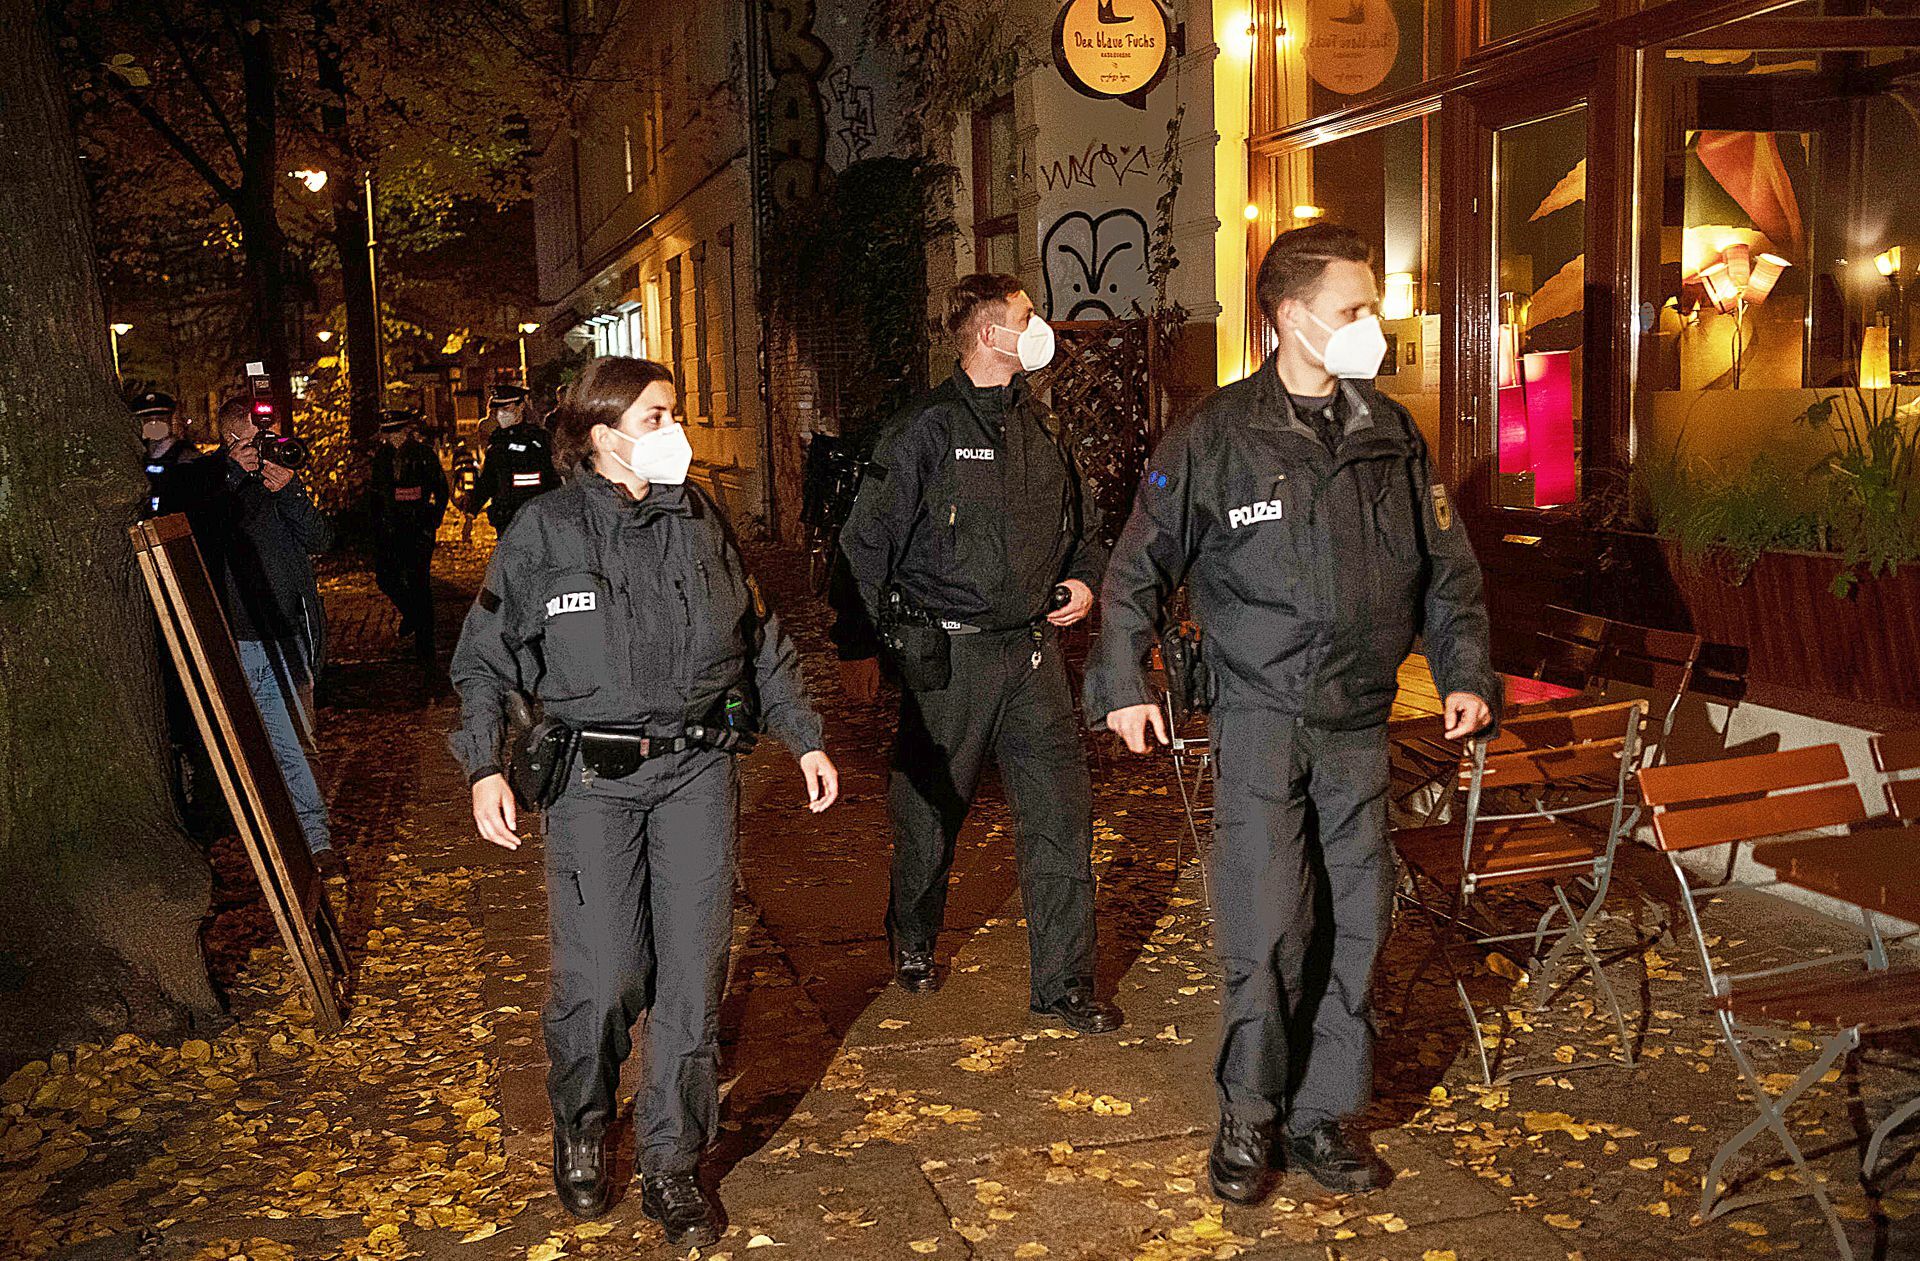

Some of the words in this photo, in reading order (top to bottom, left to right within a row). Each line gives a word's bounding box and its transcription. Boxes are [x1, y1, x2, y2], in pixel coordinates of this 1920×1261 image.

[1097, 31, 1123, 48] blaue
[1125, 34, 1155, 48] Fuchs
[955, 448, 994, 460] POLIZEI
[1228, 499, 1282, 529] POLIZEI
